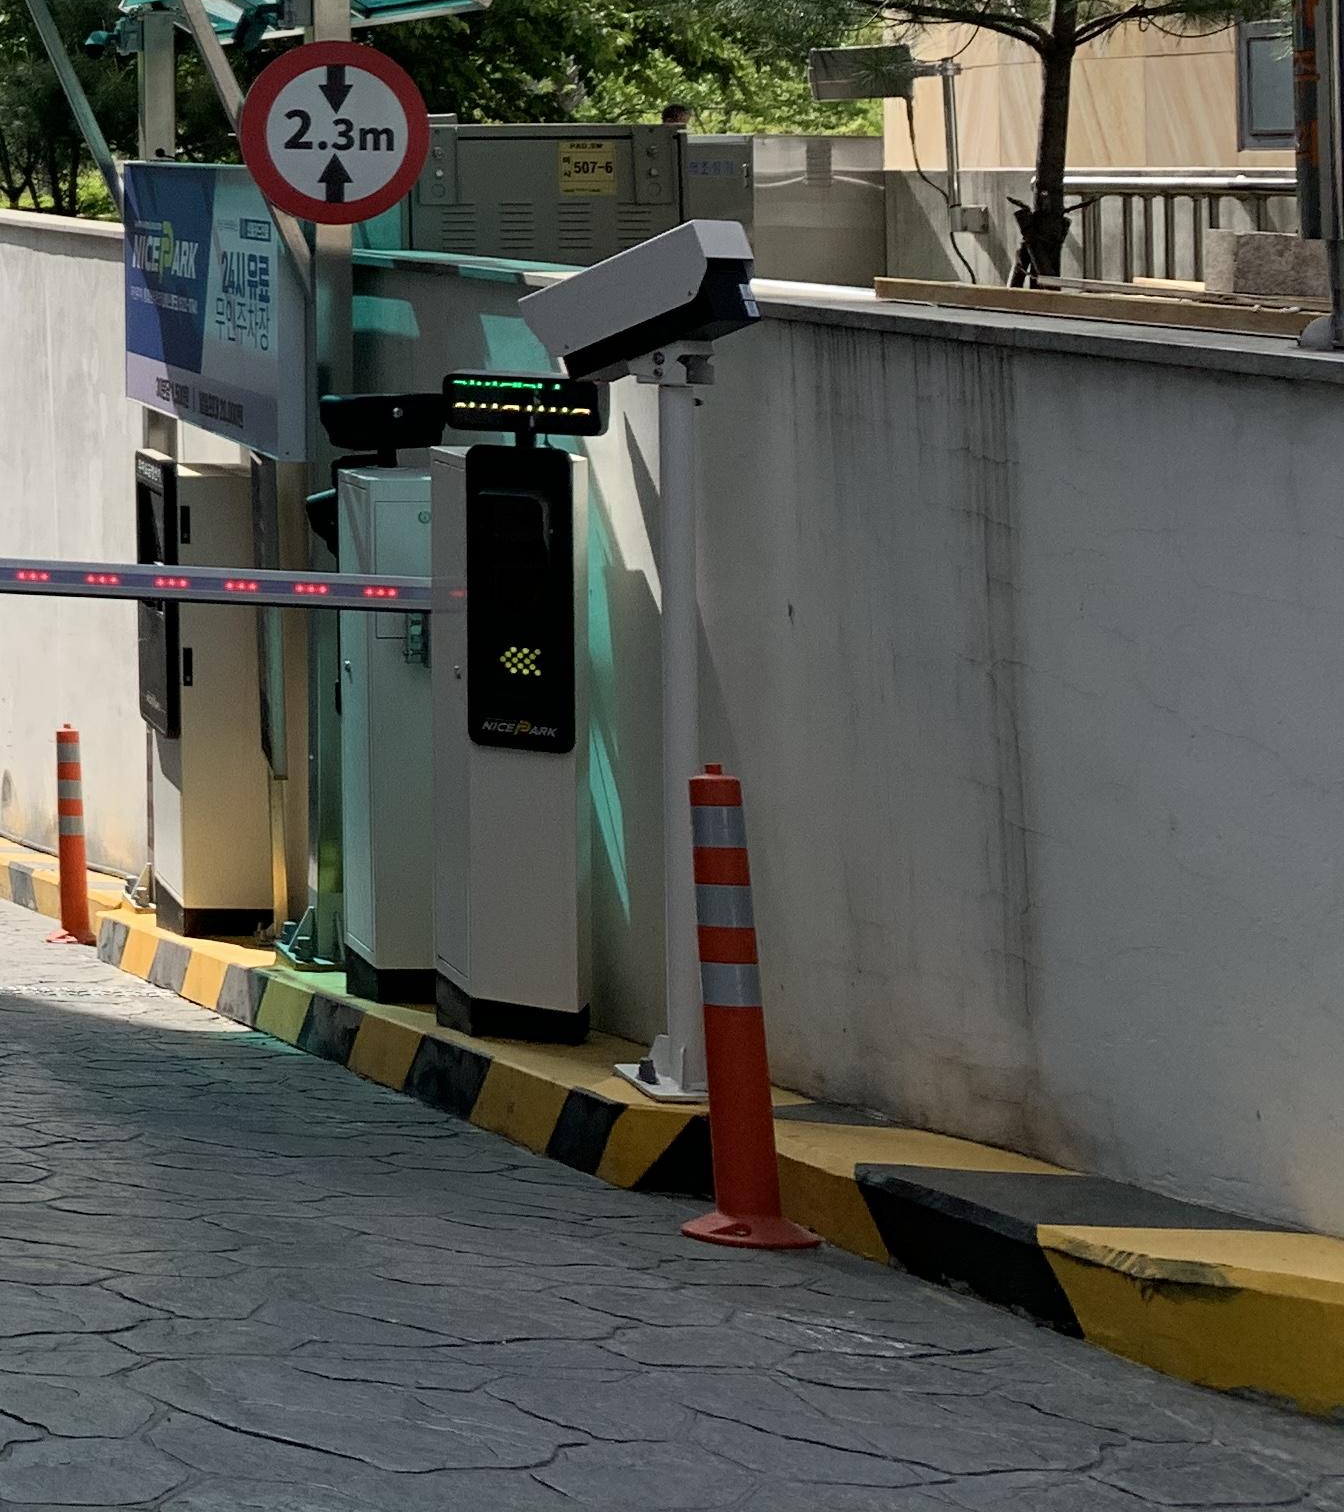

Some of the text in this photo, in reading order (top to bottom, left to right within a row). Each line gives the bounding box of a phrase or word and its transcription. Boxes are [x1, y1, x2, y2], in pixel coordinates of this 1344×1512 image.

[284, 109, 395, 152] 2.3m
[574, 161, 614, 174] 507-6
[132, 220, 199, 284] NICEPARK
[215, 297, 270, 352] 무인주차장
